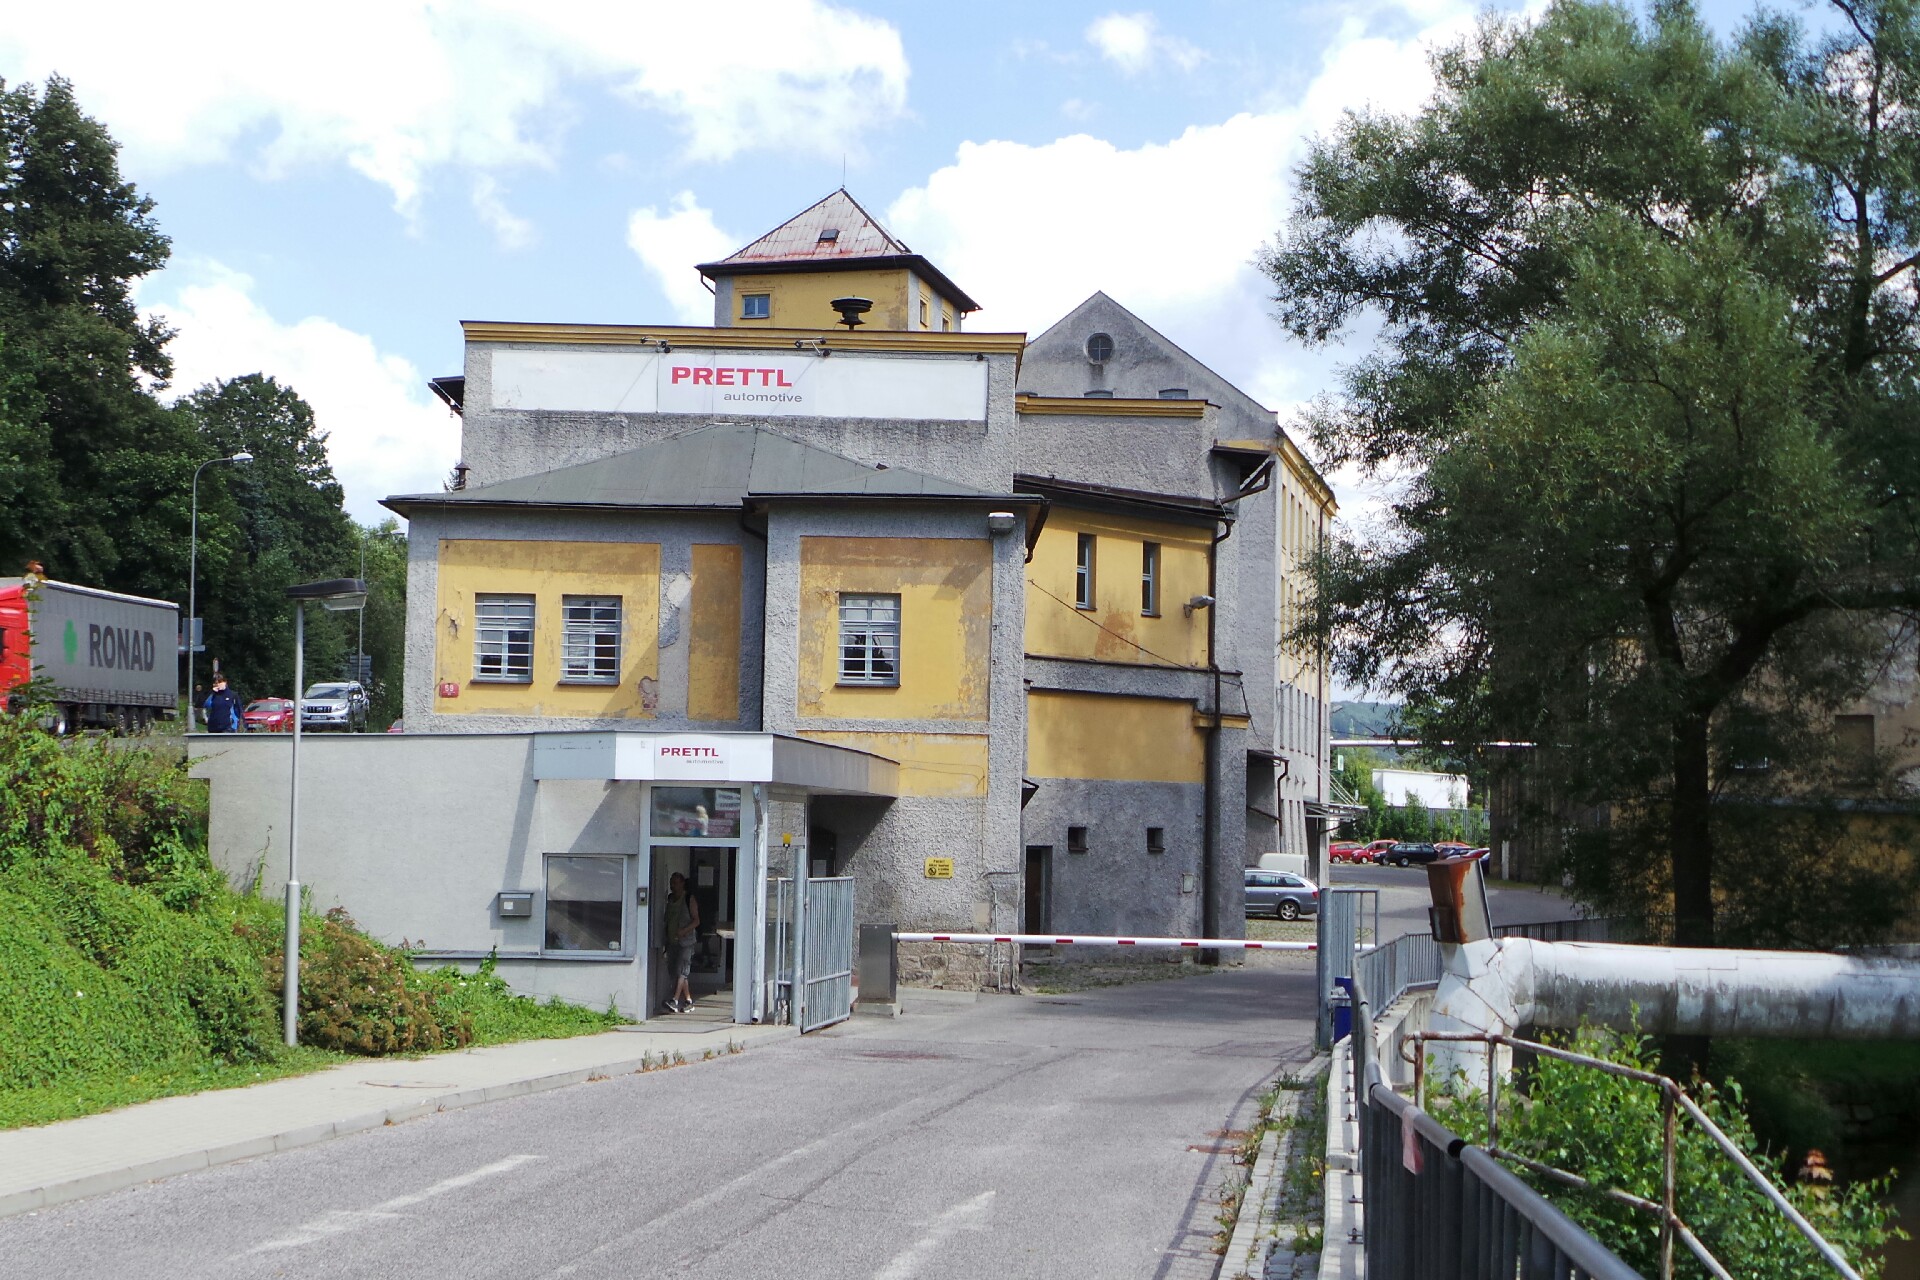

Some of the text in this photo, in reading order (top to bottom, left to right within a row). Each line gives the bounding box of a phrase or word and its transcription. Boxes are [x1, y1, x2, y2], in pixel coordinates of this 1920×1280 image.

[671, 366, 793, 387] PRETTL
[723, 392, 802, 402] automotive
[89, 623, 155, 672] RONAD
[661, 747, 719, 757] PRETTL
